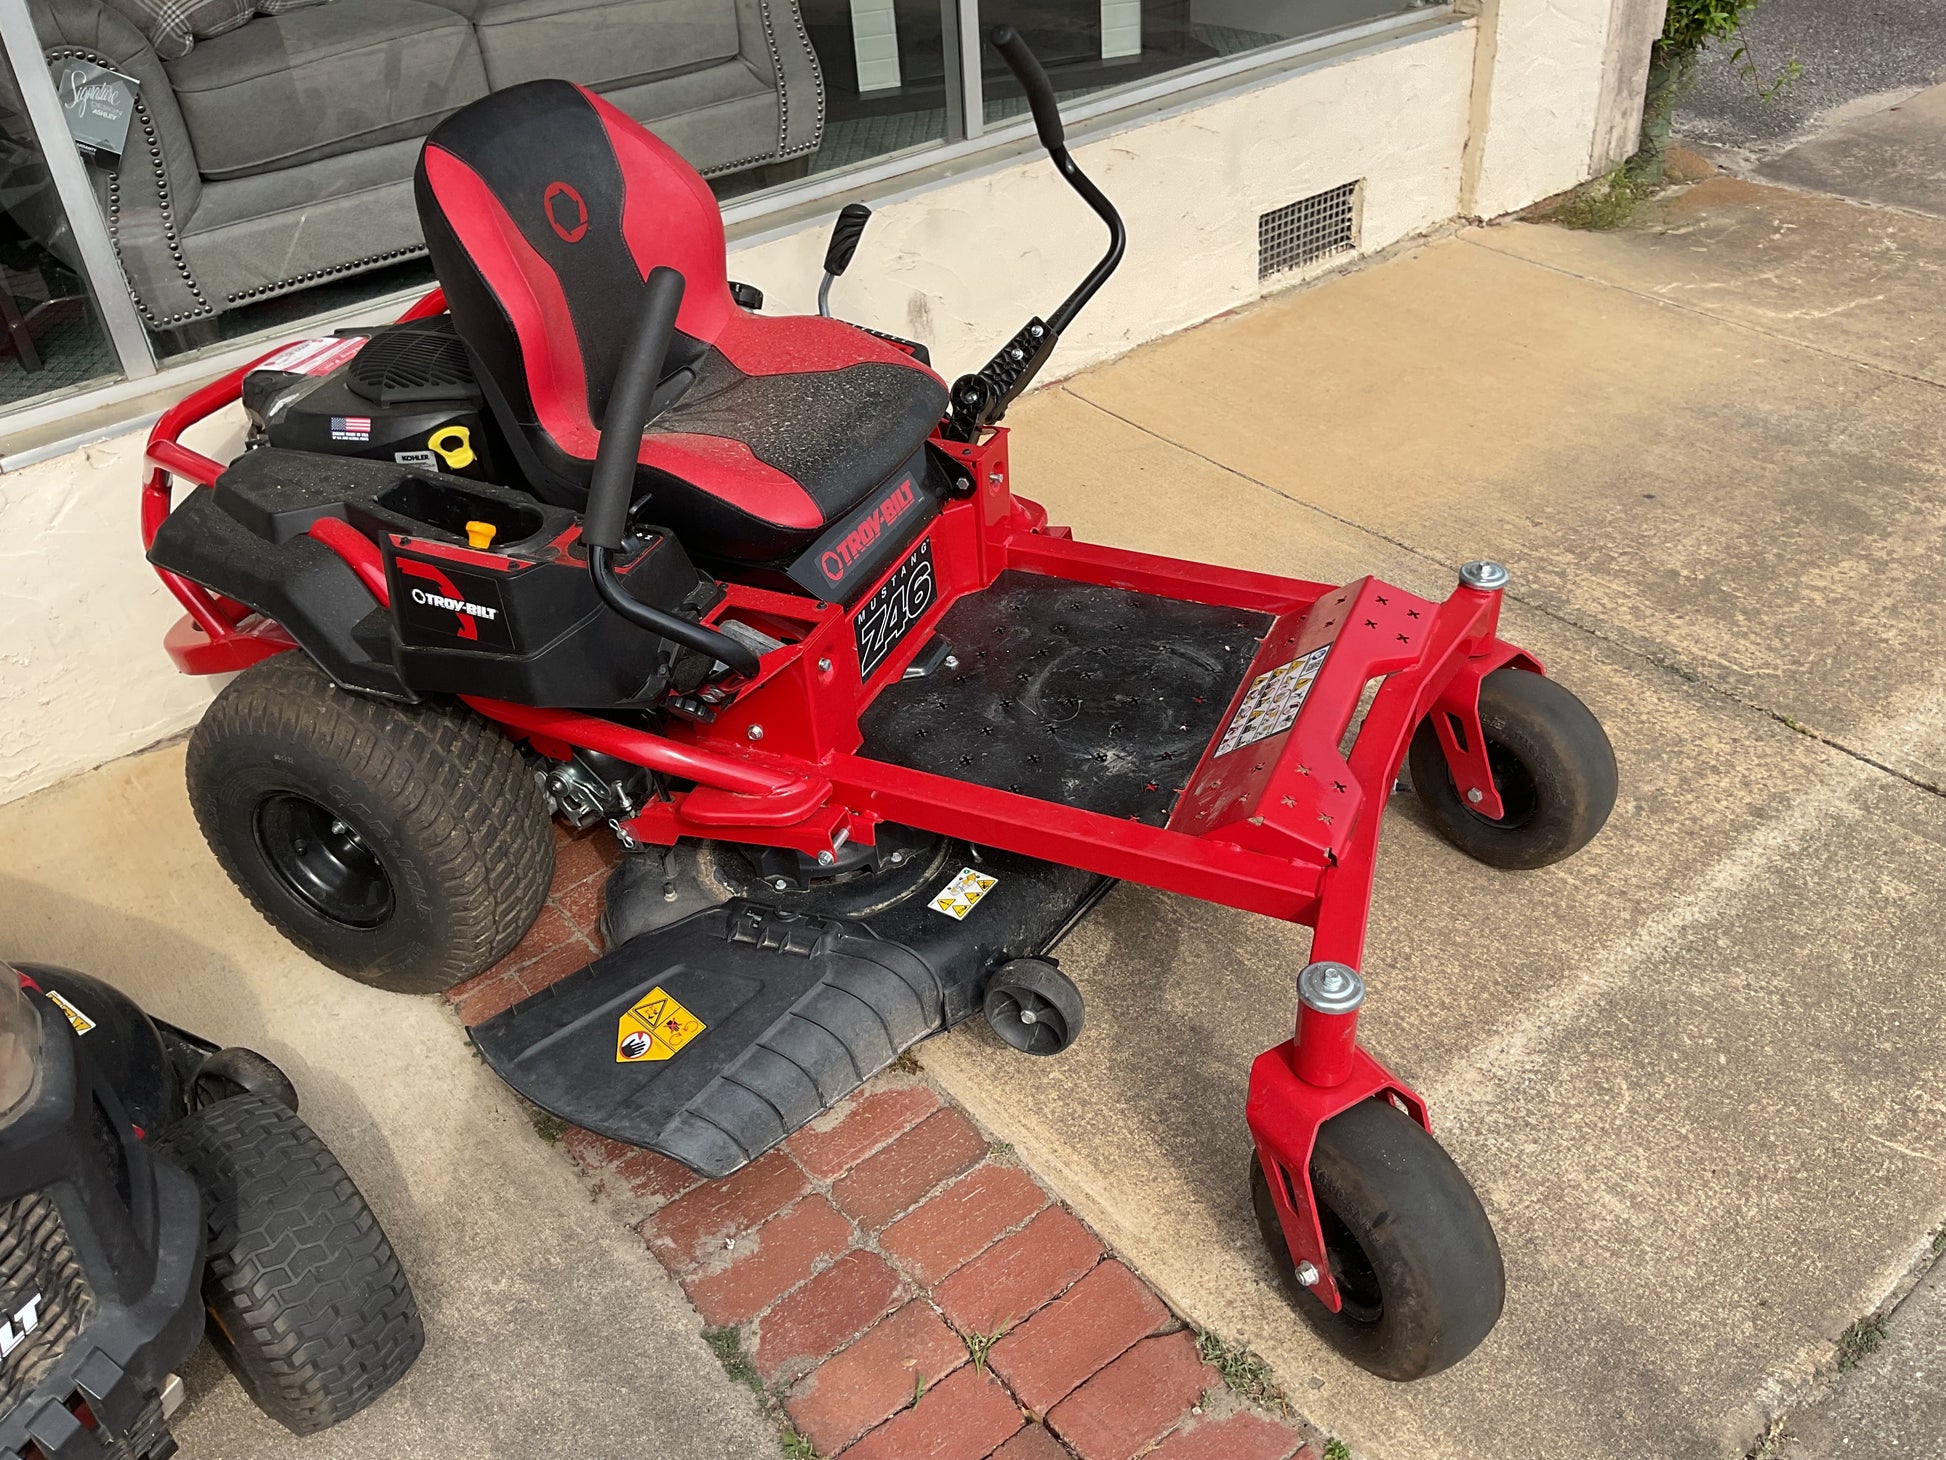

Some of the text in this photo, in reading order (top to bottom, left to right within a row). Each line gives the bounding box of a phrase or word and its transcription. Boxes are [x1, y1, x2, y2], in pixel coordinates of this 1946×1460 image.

[64, 70, 121, 118] Signature
[92, 109, 118, 121] ASHLEY
[401, 454, 430, 462] KOHLER
[835, 479, 915, 567] TROY-BILT
[424, 592, 497, 620] TROY-BILT
[857, 541, 928, 625] MUSTANG
[861, 560, 932, 678] Z46
